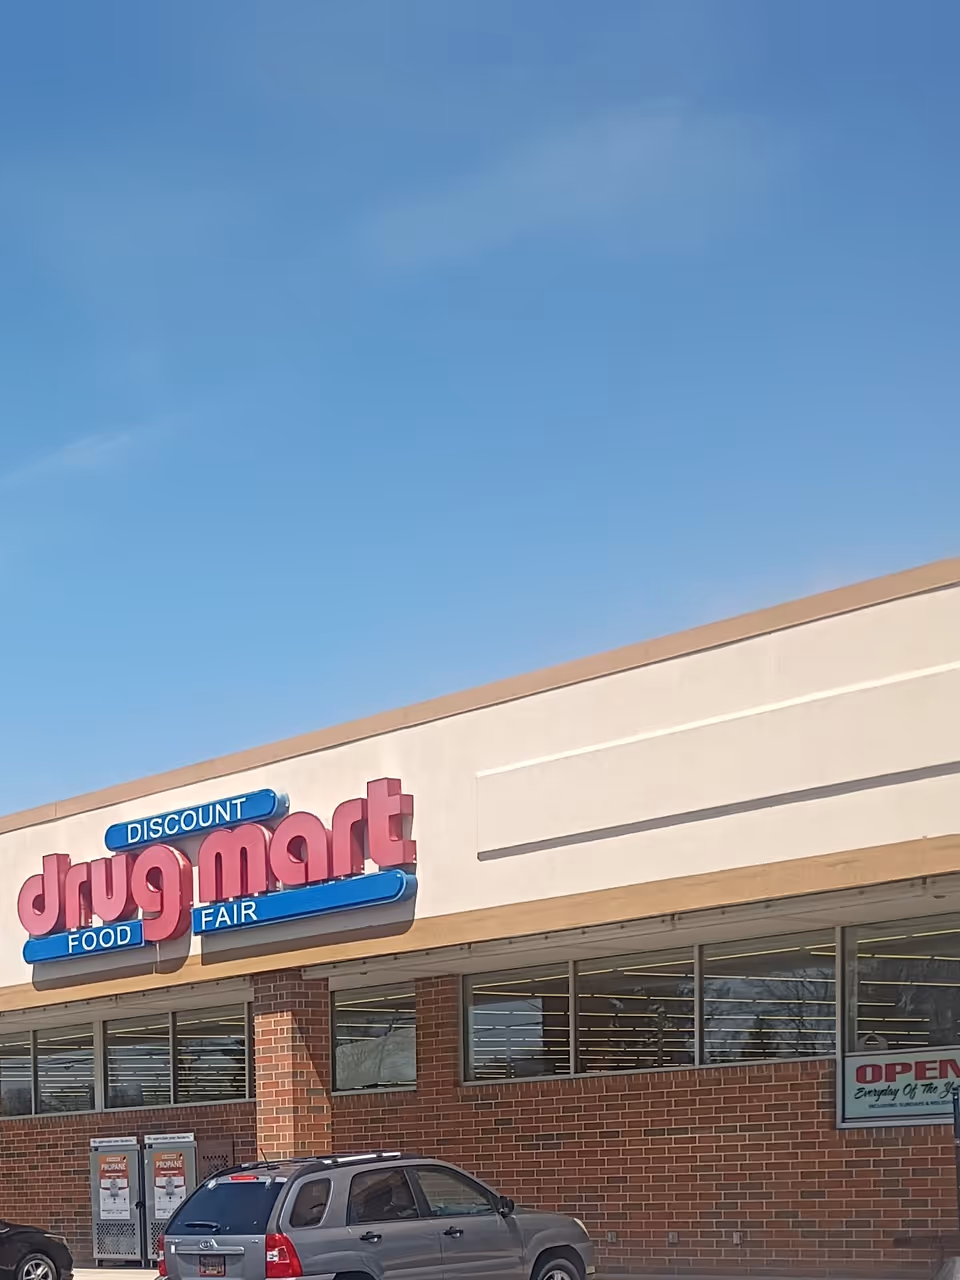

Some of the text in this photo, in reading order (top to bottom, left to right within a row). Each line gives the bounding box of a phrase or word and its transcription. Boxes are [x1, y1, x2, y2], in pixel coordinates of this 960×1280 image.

[126, 798, 246, 845] DISCOUNT
[17, 778, 414, 942] drug mart
[67, 901, 258, 954] FOOD FAIR
[856, 1059, 960, 1084] OPEN
[855, 1085, 899, 1101] Everyday
[903, 1084, 917, 1099] Of
[921, 1083, 937, 1094] The
[155, 1160, 183, 1169] PROPANE
